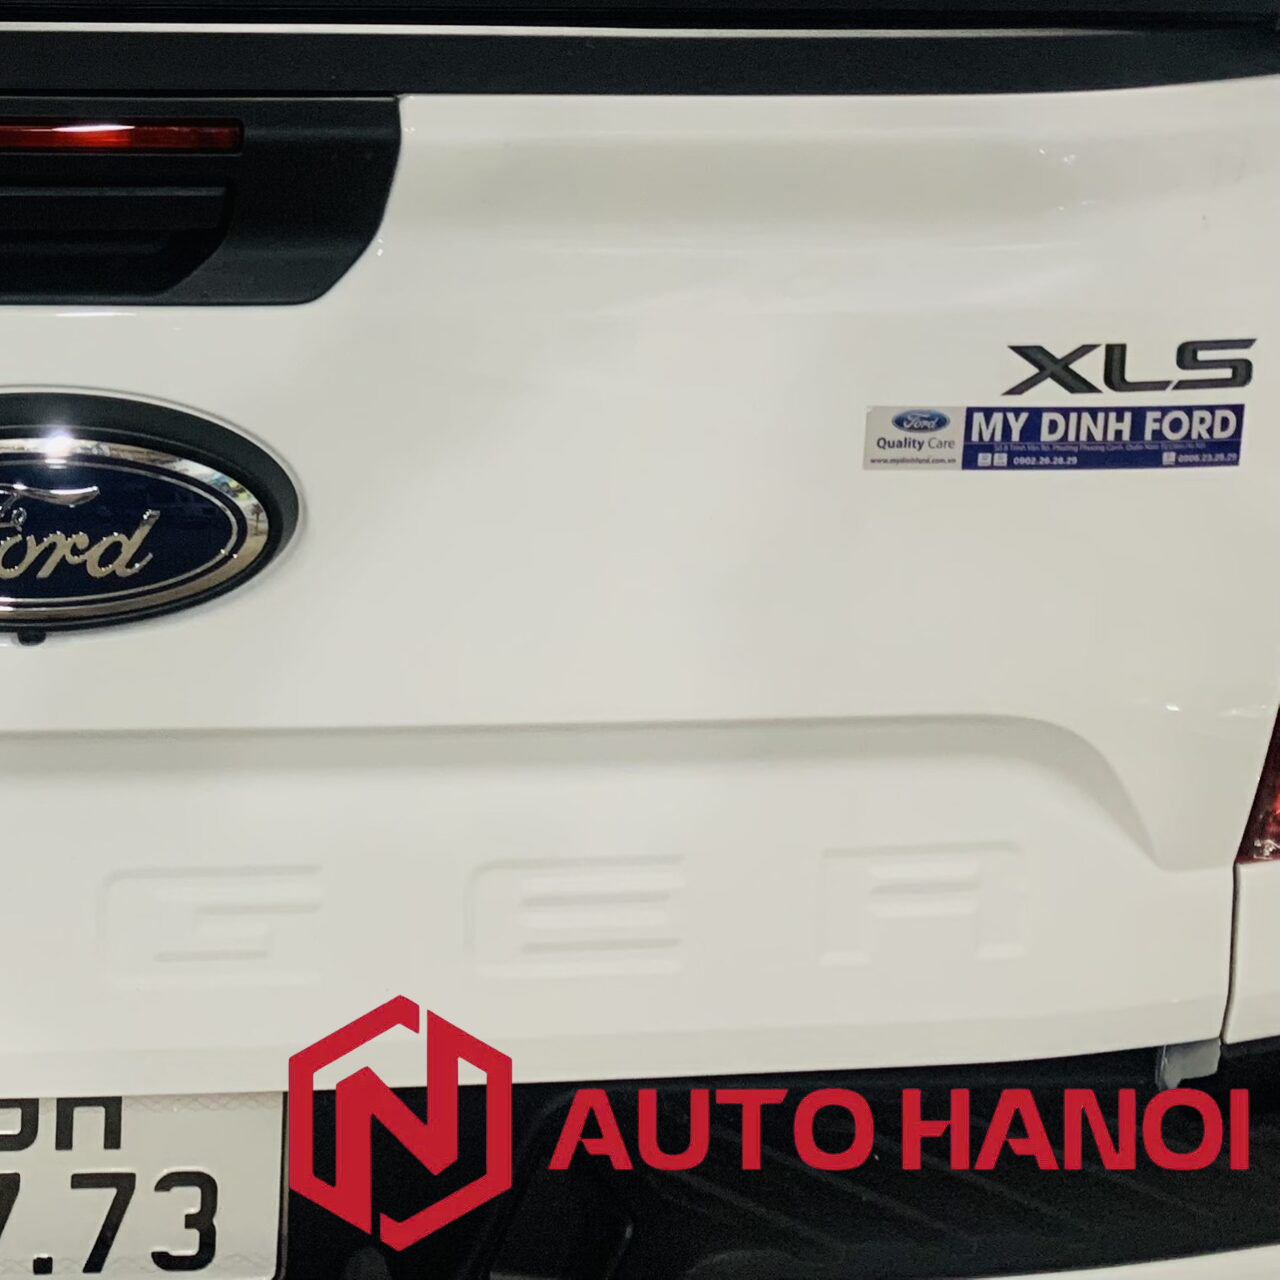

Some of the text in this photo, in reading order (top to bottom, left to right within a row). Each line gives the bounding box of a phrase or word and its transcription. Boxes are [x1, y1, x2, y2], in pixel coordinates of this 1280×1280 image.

[1001, 338, 1257, 396] XLS
[903, 412, 939, 429] Ford
[971, 409, 1237, 442] MY DINH FORD
[876, 437, 956, 452] Quality Care
